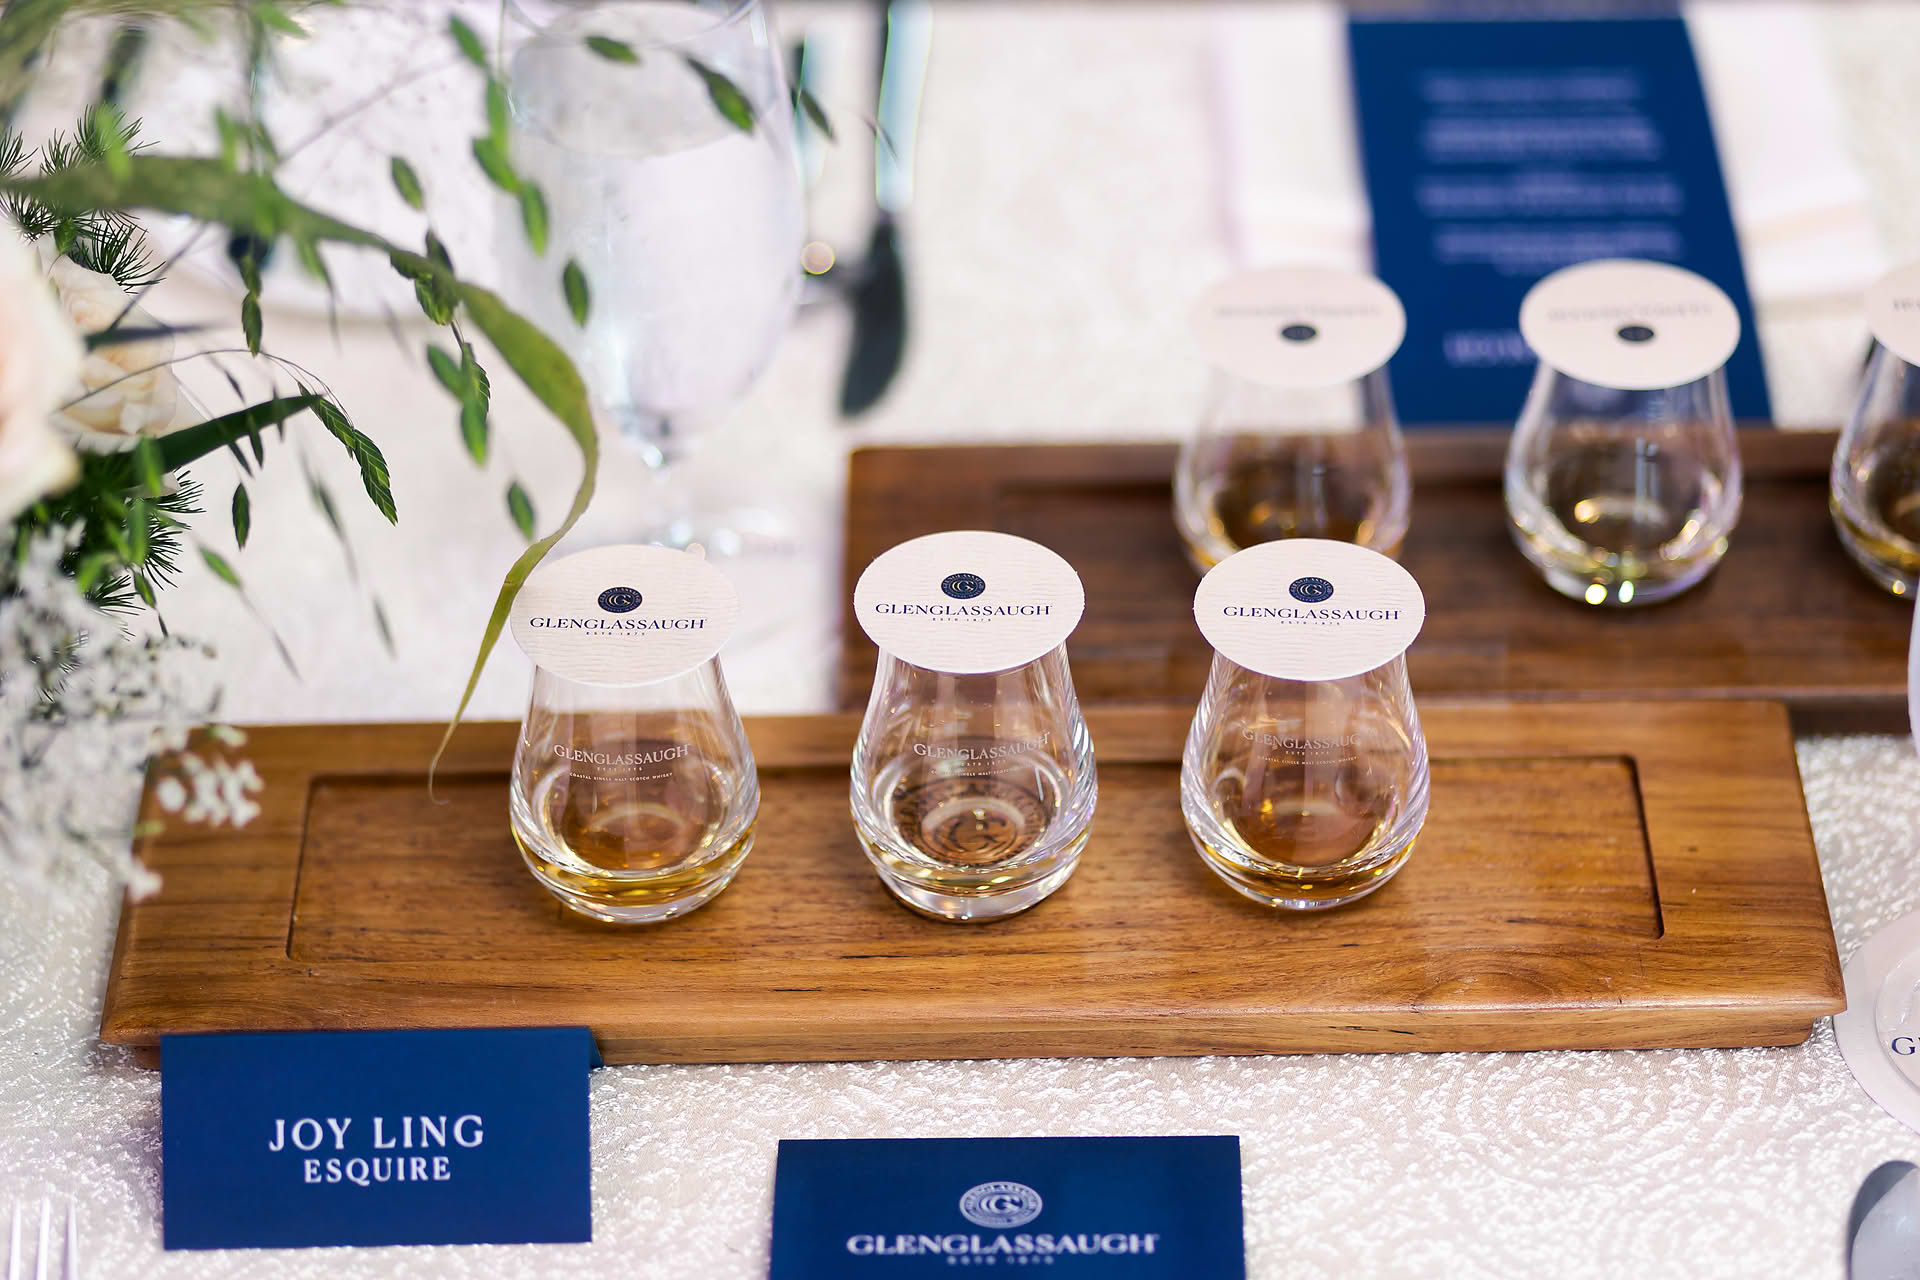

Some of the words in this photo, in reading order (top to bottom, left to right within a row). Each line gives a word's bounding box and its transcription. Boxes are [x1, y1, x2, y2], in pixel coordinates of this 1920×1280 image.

[875, 603, 1051, 616] GLENGLASSAUGH
[1223, 606, 1400, 621] GLENGLASSAUGH
[530, 617, 706, 630] GLENGLASSAUGH
[553, 744, 689, 766] GLENGLASSAUGH
[268, 1117, 352, 1151] JOY
[373, 1114, 484, 1148] LING
[303, 1156, 451, 1187] ESQUIRE
[846, 1233, 1156, 1256] GLENGLASSAUGH
